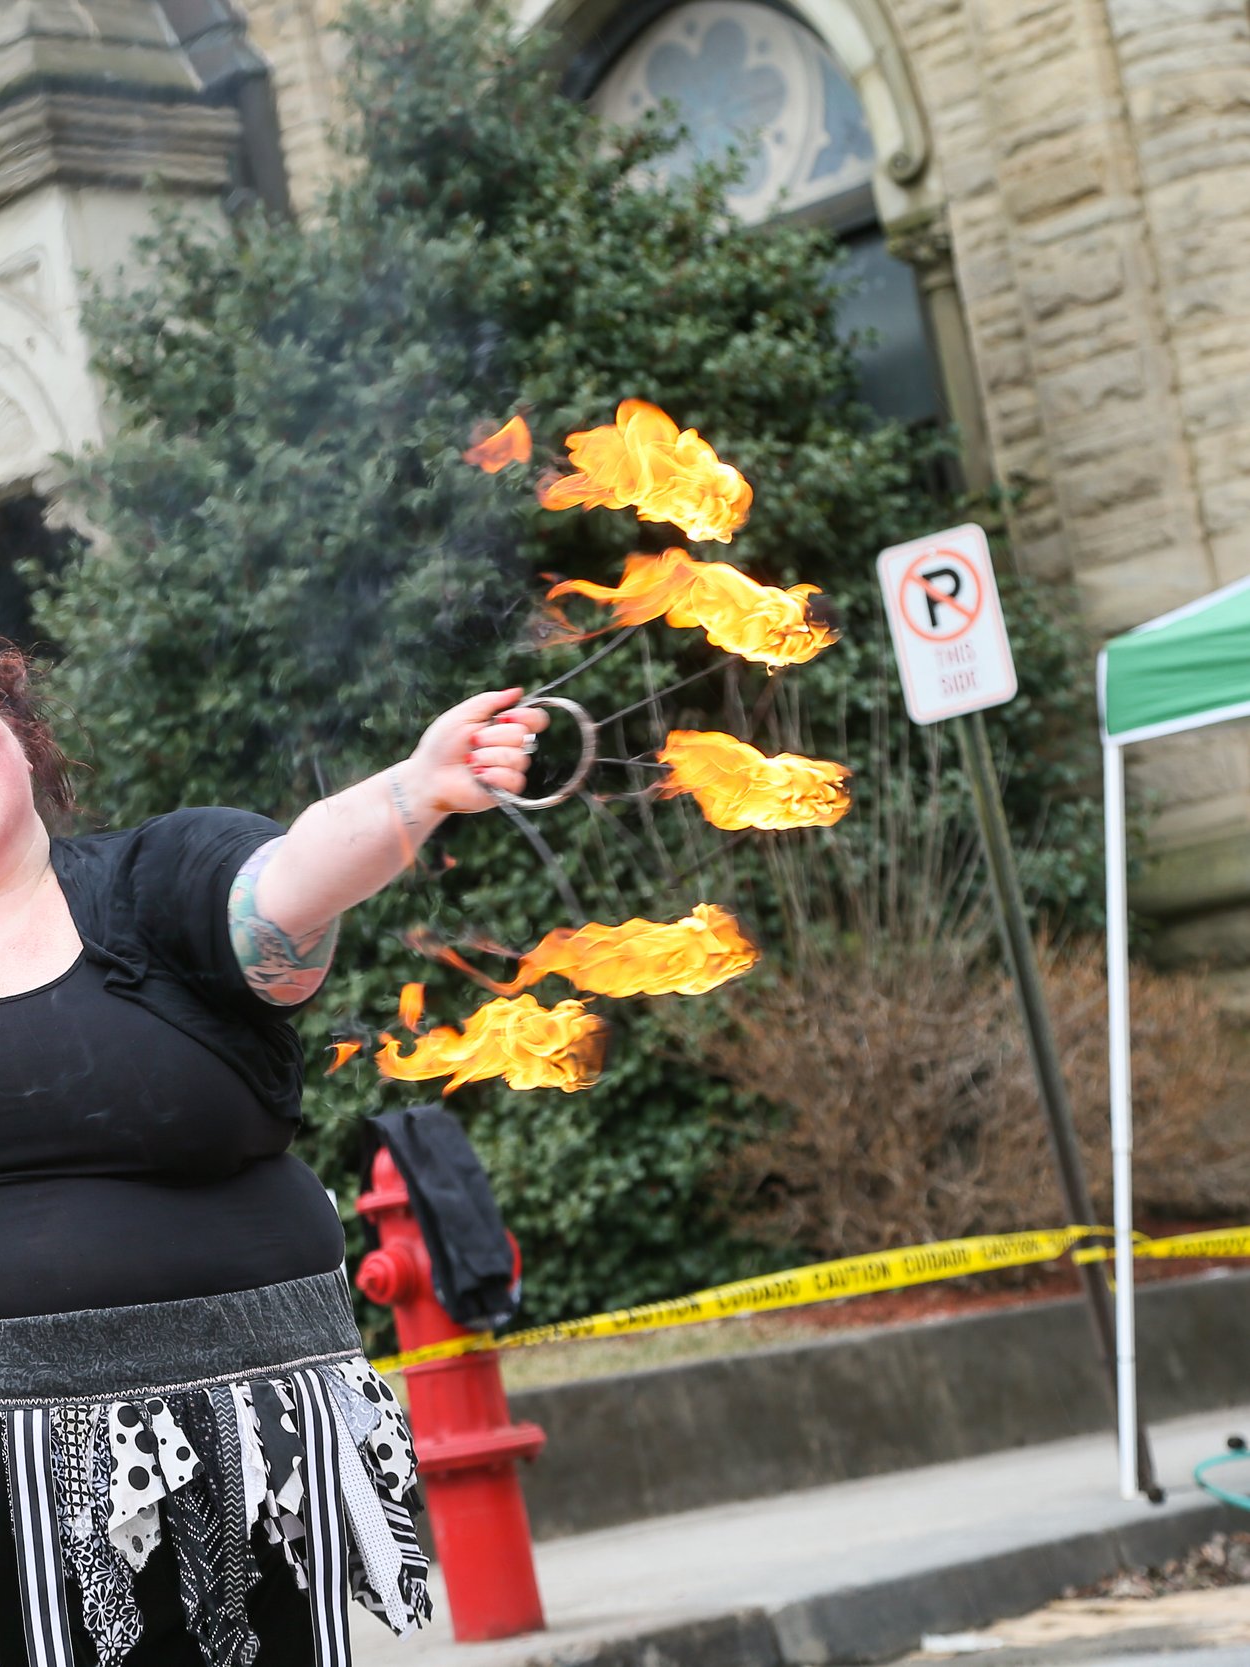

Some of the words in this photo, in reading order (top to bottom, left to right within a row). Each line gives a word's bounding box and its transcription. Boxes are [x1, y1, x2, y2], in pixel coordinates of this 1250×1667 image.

[934, 641, 977, 666] THIS
[940, 670, 979, 696] SIDE
[813, 1260, 891, 1291] CAUTION
[904, 1248, 973, 1277] CUIDADO
